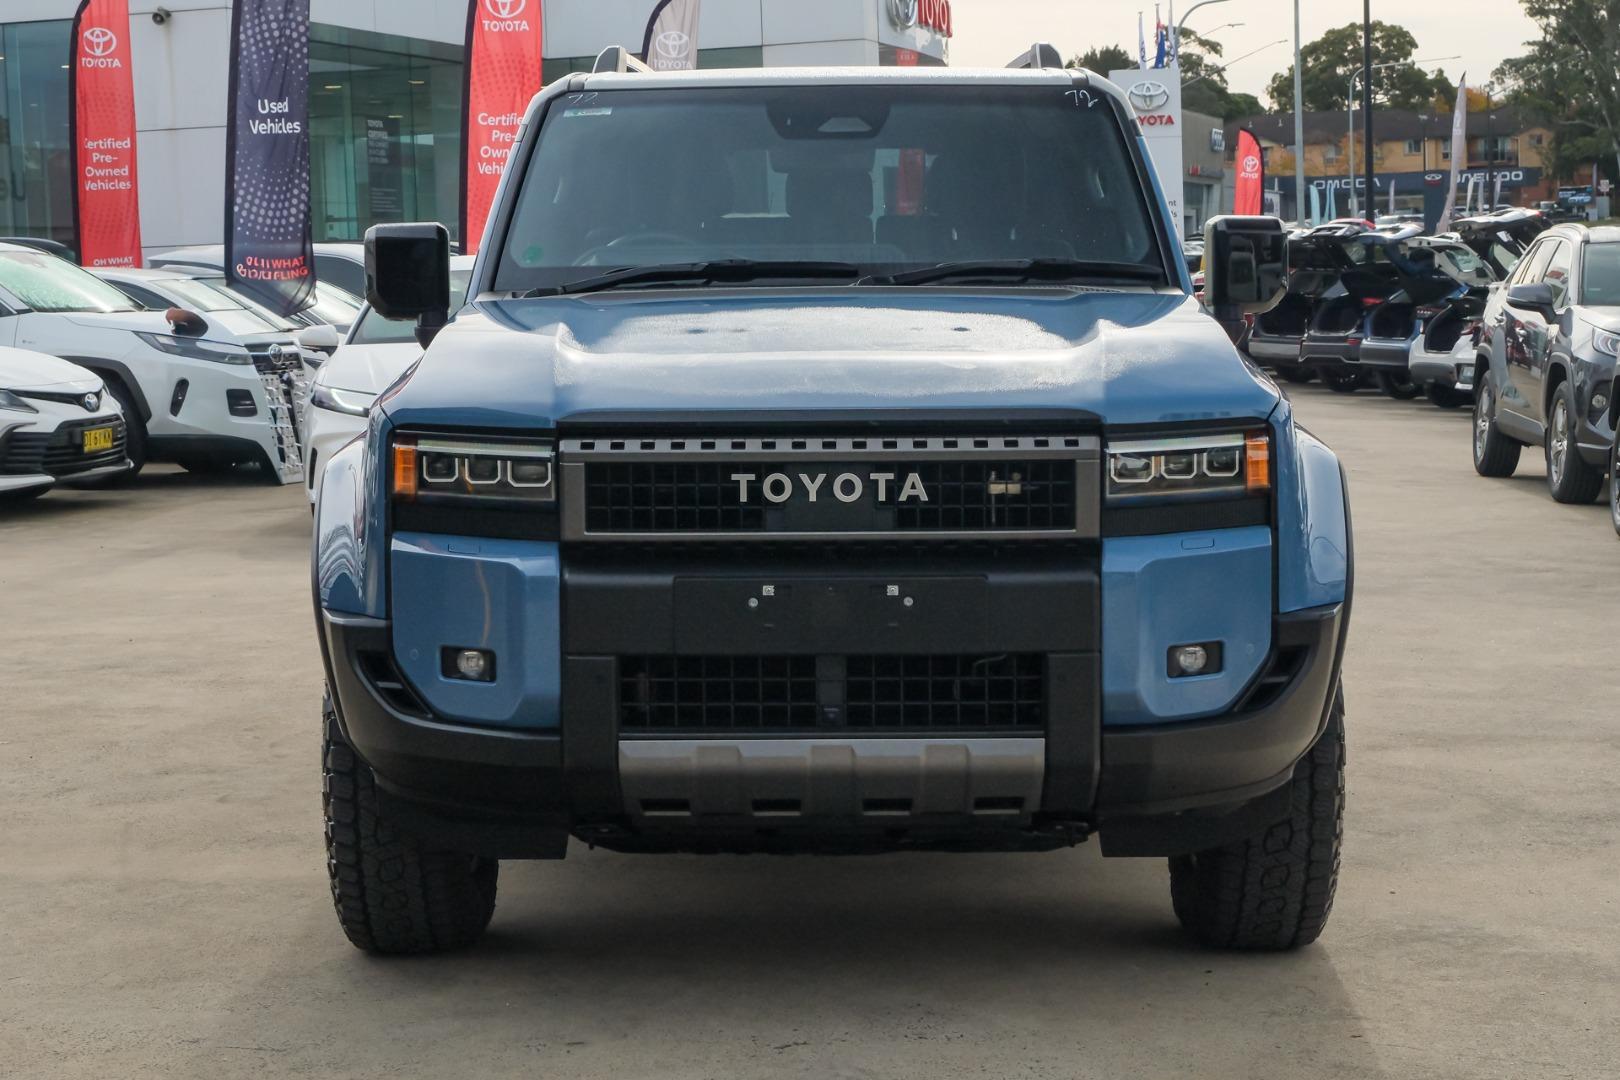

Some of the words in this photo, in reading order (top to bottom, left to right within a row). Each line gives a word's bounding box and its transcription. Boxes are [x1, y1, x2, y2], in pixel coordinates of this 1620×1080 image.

[482, 19, 530, 32] TOYOTA
[257, 96, 289, 114] Used
[478, 112, 523, 126] Certifie
[1138, 114, 1174, 126] YOTA
[249, 118, 301, 135] Vehicles
[491, 129, 516, 142] Pre-
[92, 152, 119, 163] Pre-
[480, 145, 511, 158] Own
[85, 164, 129, 177] Owned
[477, 161, 505, 175] Vehi
[93, 258, 107, 266] OH
[108, 256, 133, 265] WHAT
[271, 256, 304, 269] WHAT
[731, 472, 929, 503] TOYOTA
